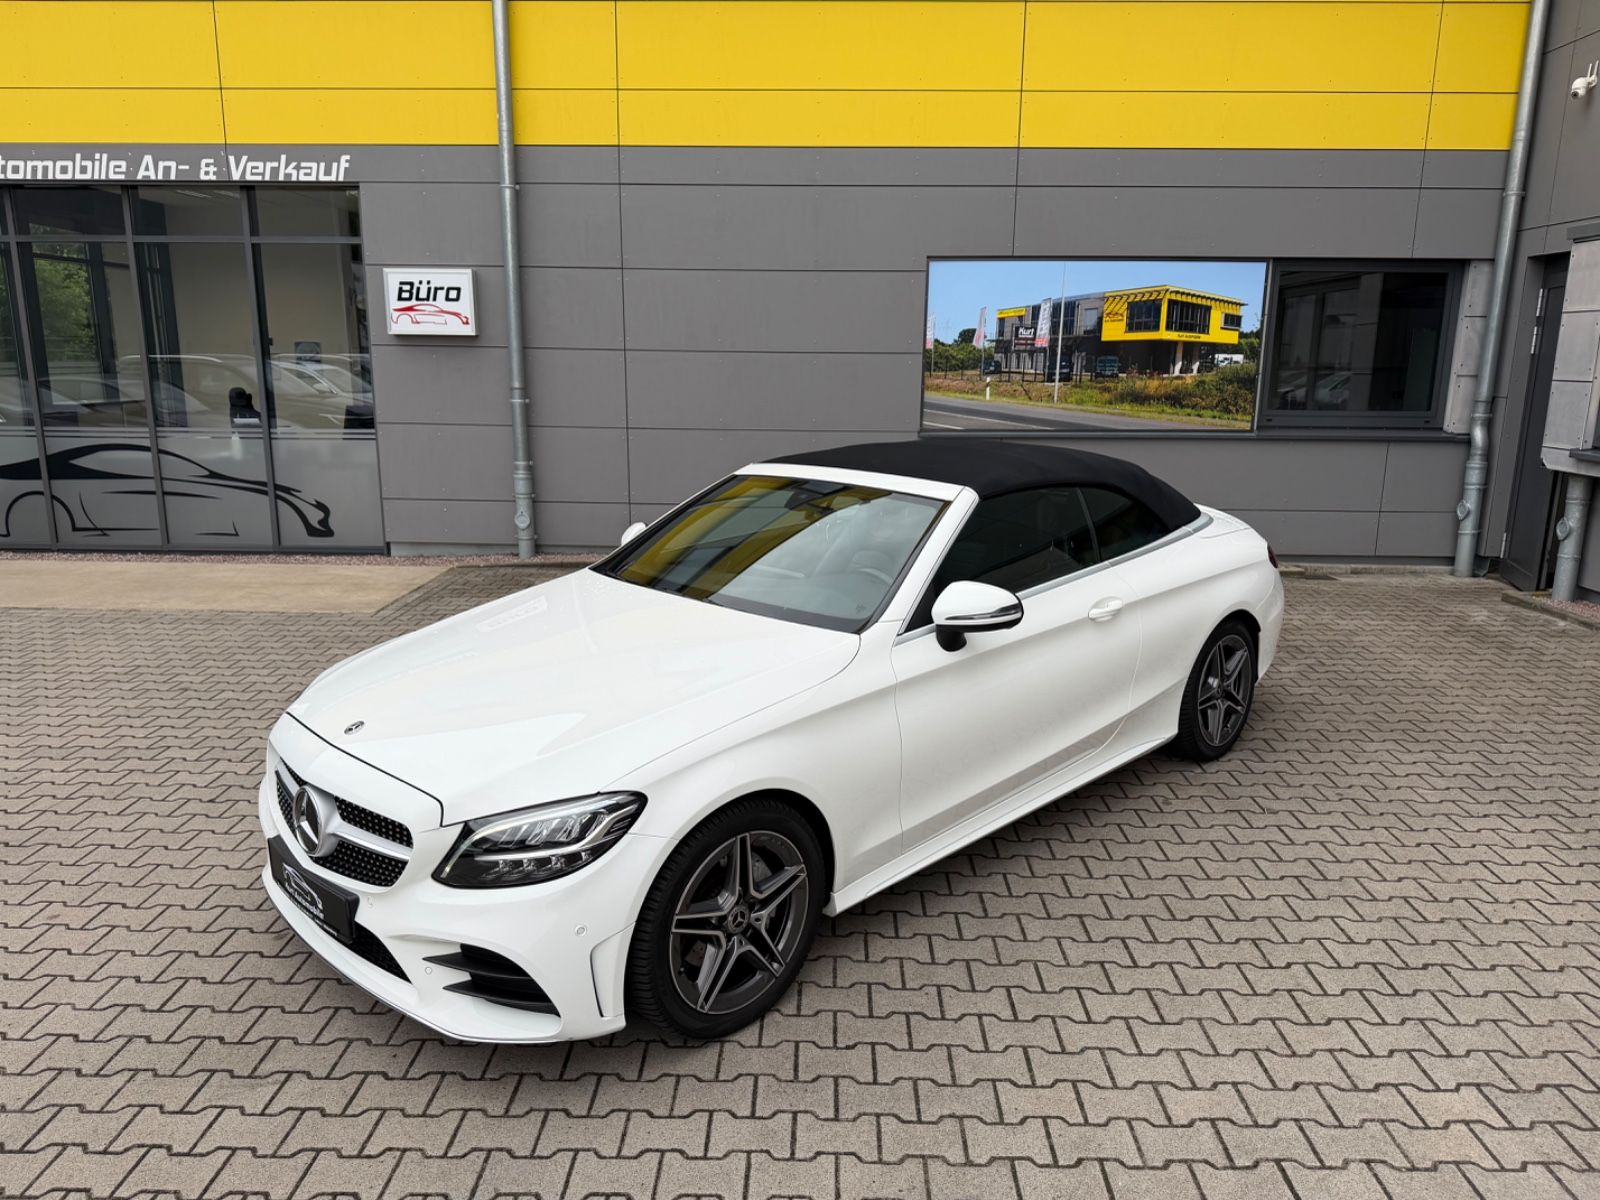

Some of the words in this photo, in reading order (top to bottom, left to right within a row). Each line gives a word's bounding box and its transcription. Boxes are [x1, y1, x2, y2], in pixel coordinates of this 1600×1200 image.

[136, 154, 190, 180] An-
[199, 158, 218, 180] &
[228, 154, 351, 181] Verkauf
[397, 280, 462, 302] Büro
